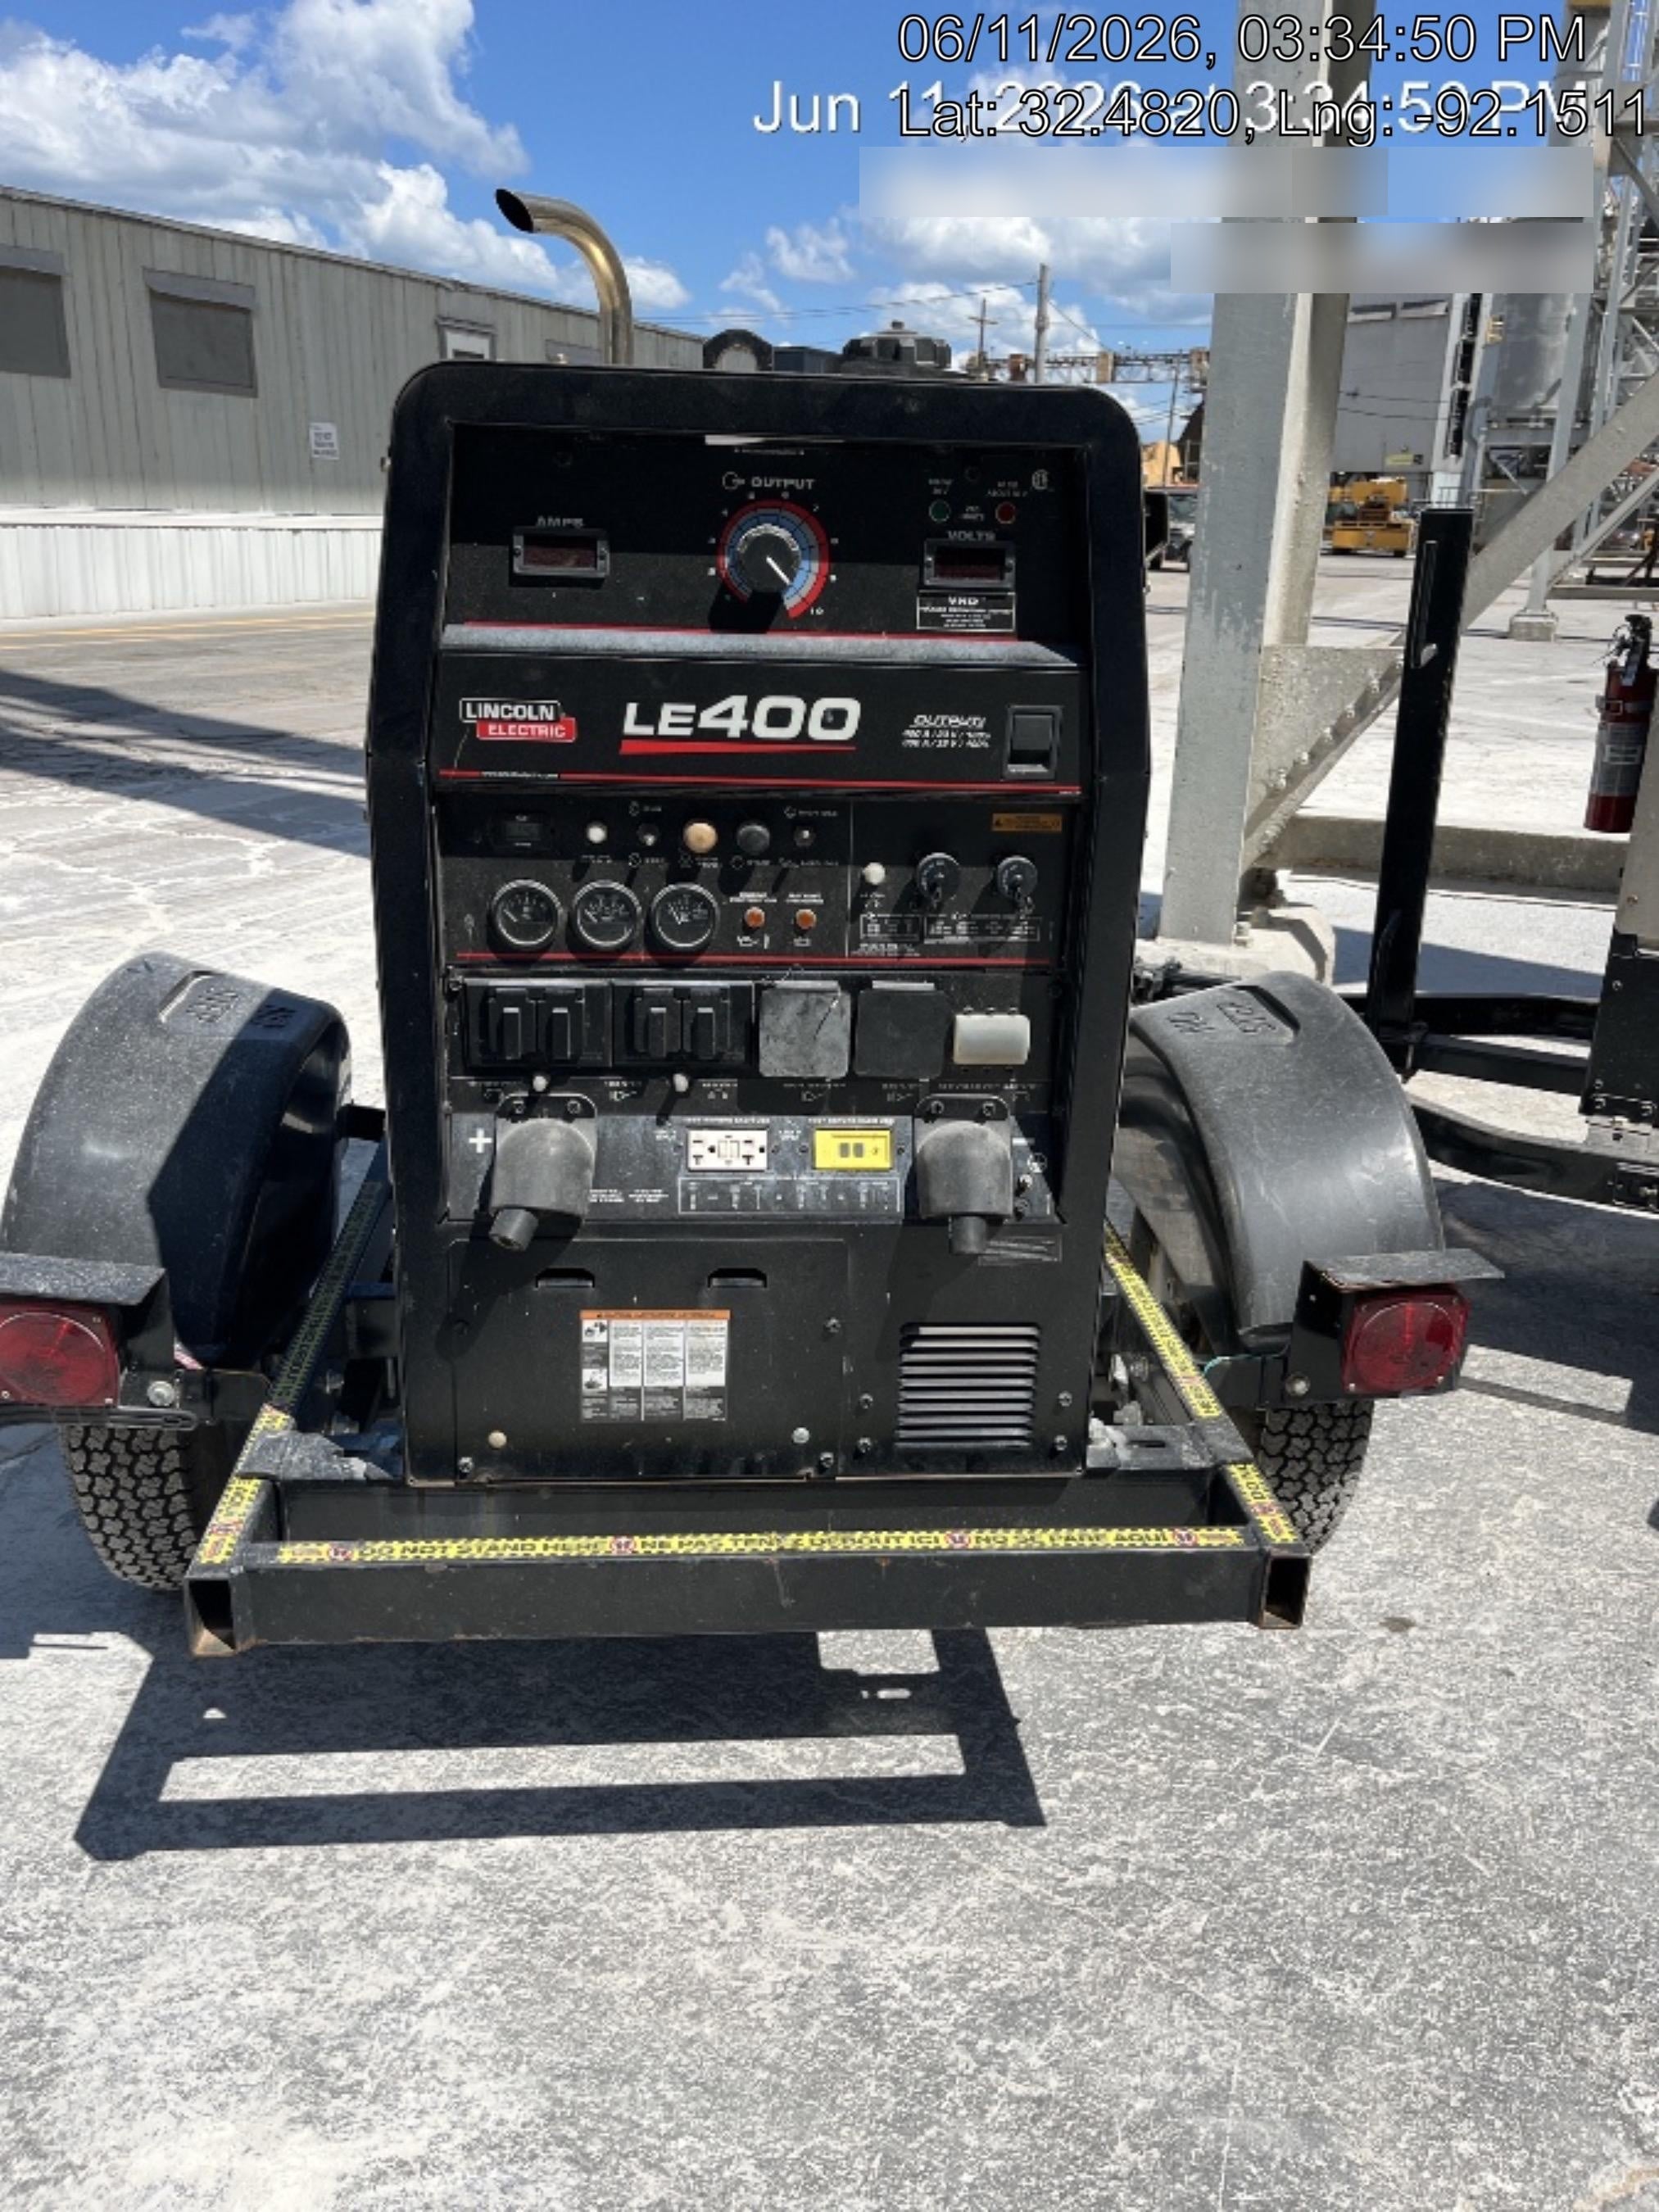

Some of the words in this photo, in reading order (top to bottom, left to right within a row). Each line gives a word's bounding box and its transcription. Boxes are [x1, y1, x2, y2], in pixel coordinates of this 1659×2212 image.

[750, 476, 816, 490] OUTPUT
[535, 515, 584, 528] AMPS
[946, 530, 996, 542] VOLTS
[465, 702, 555, 721] LINCOLN
[622, 694, 862, 741] LE400
[487, 723, 567, 738] ELECTRIC
[400, 1544, 448, 1556] NOT
[456, 1542, 538, 1555] STAND
